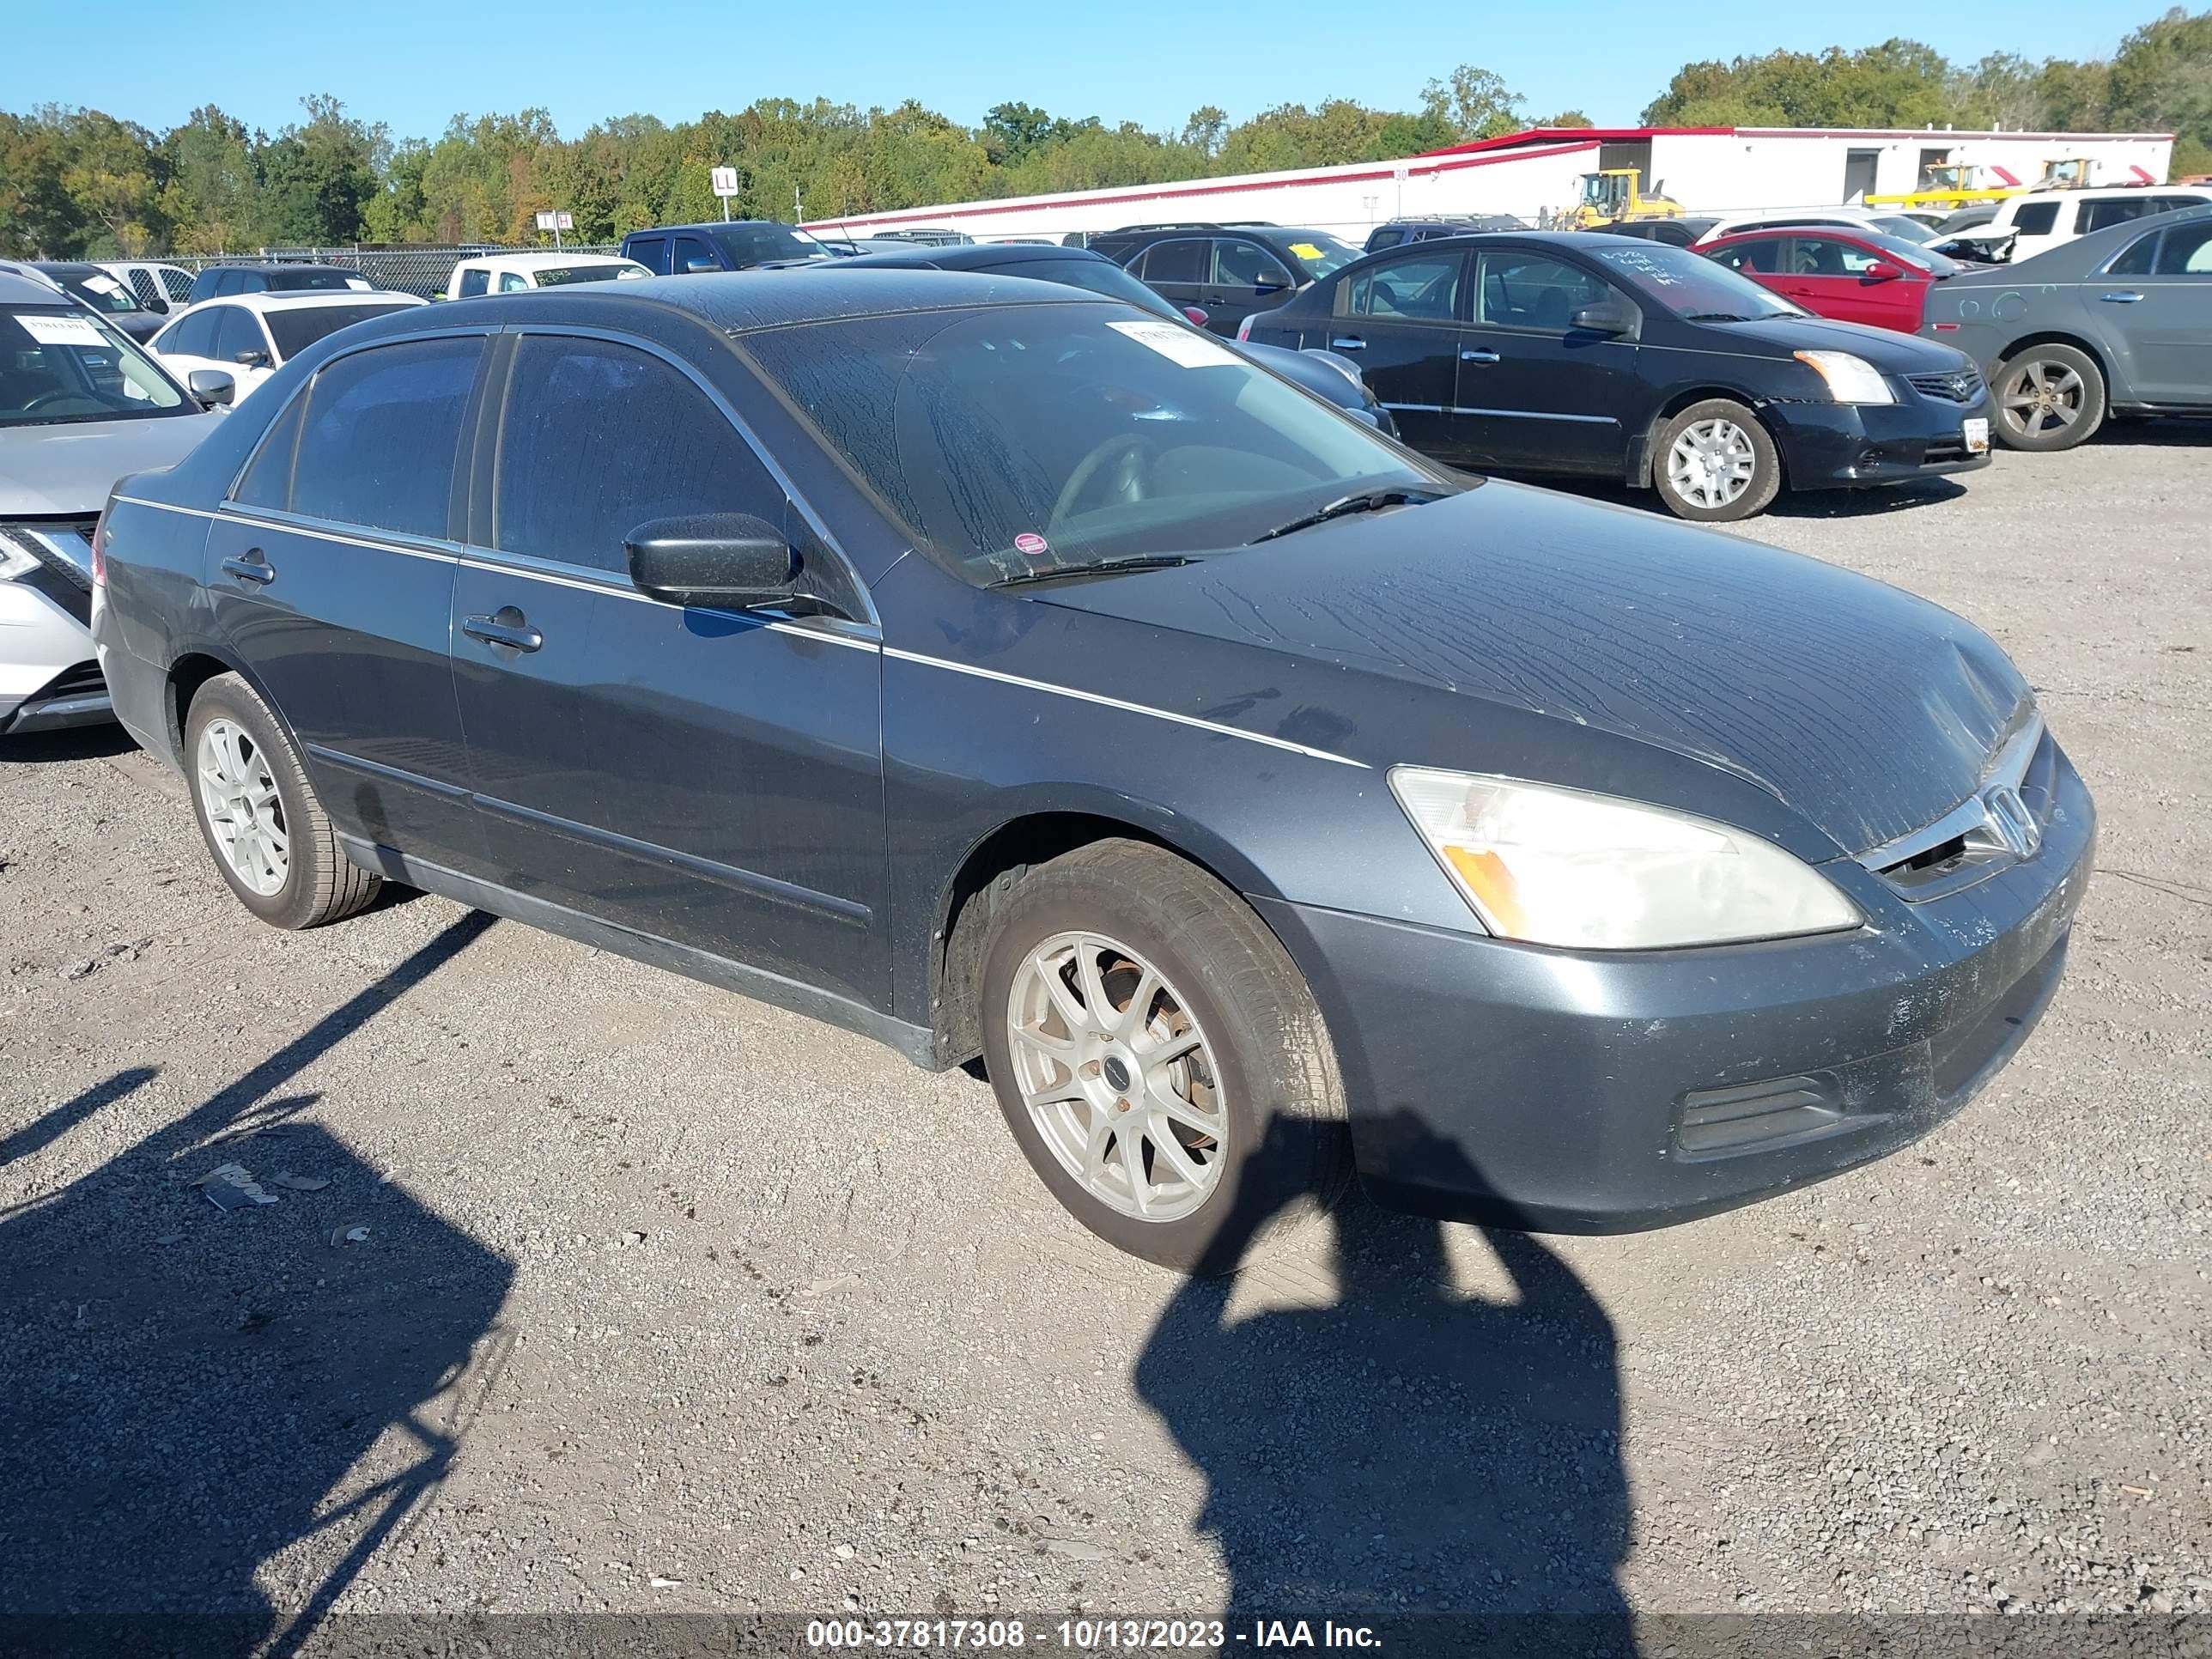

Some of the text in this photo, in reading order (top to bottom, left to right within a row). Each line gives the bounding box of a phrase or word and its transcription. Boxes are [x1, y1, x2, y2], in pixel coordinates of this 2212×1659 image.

[1395, 169, 1407, 181] 30
[715, 173, 735, 190] LL
[559, 215, 568, 227] H
